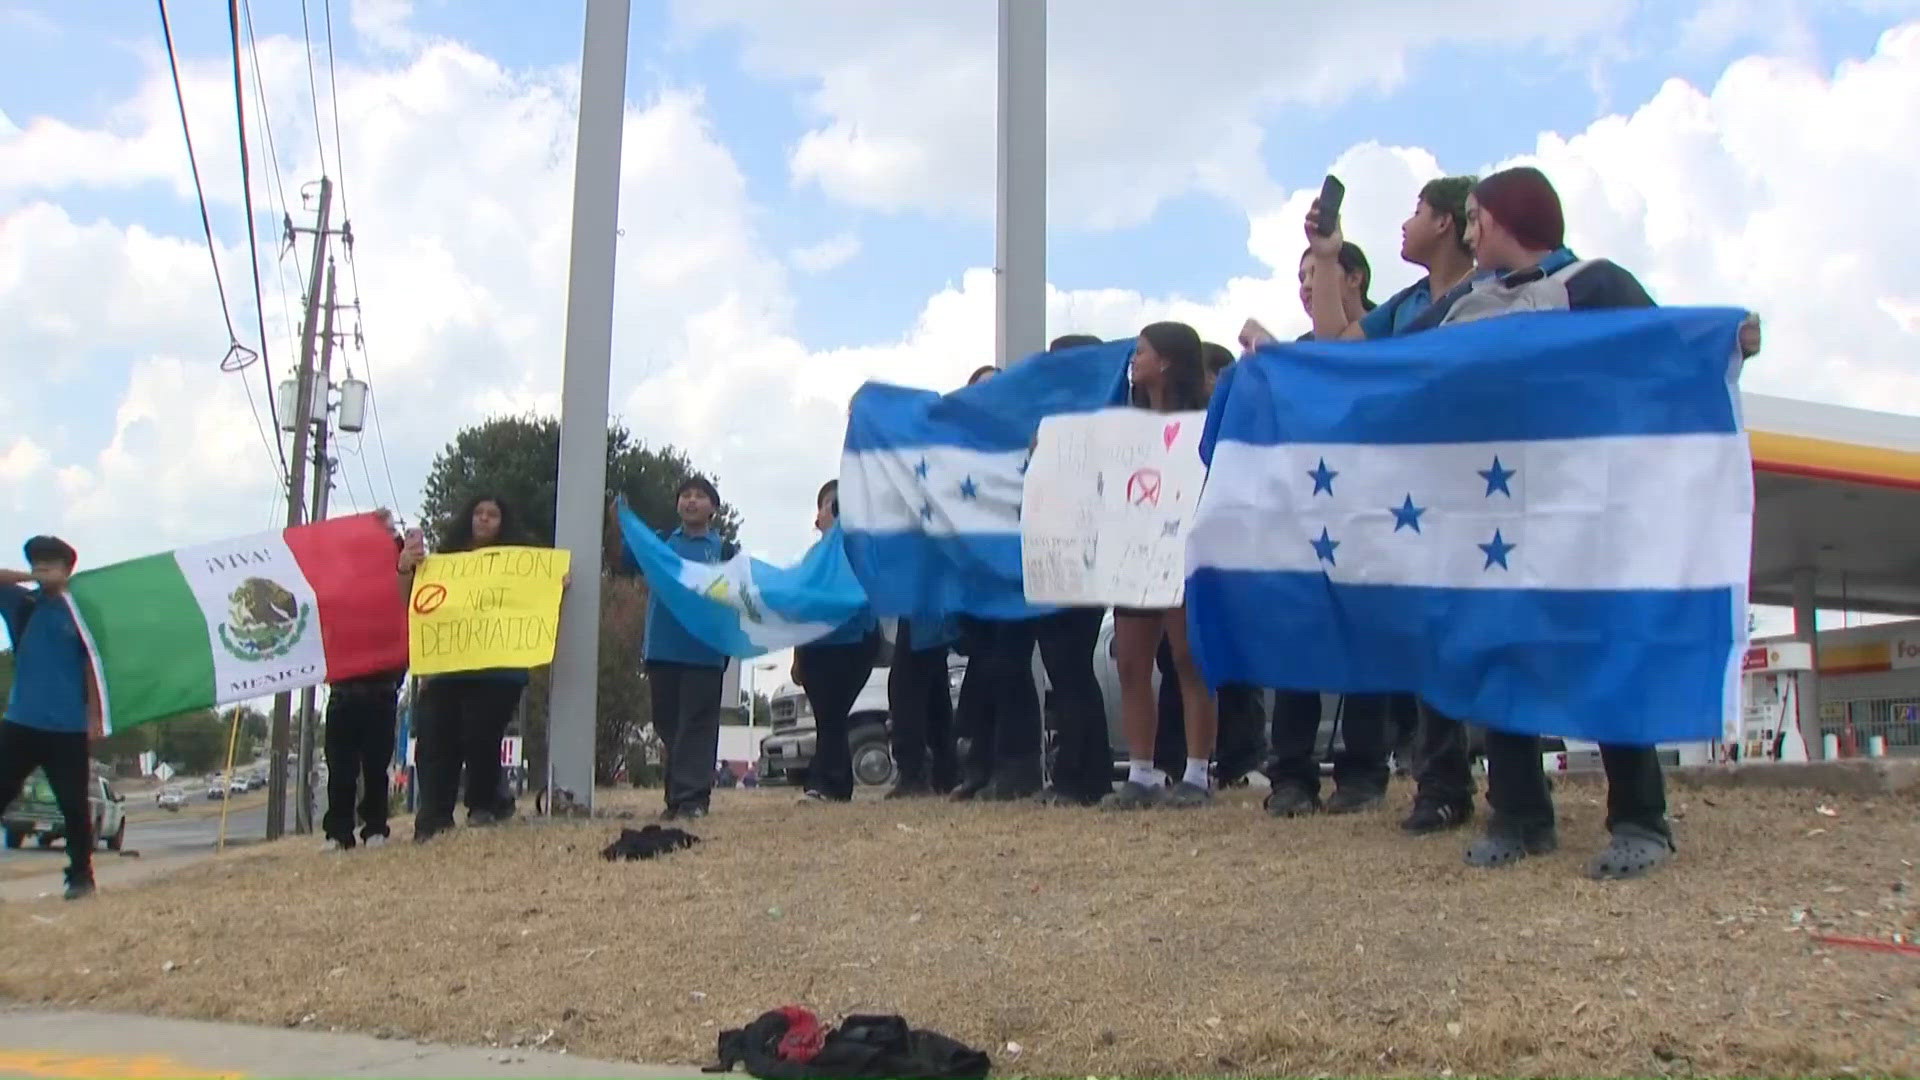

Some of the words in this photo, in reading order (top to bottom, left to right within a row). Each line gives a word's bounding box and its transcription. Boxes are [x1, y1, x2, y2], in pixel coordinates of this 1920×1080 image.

[462, 586, 512, 612] NOT
[420, 615, 555, 659] DEPORTATION
[230, 664, 316, 692] MEXICO
